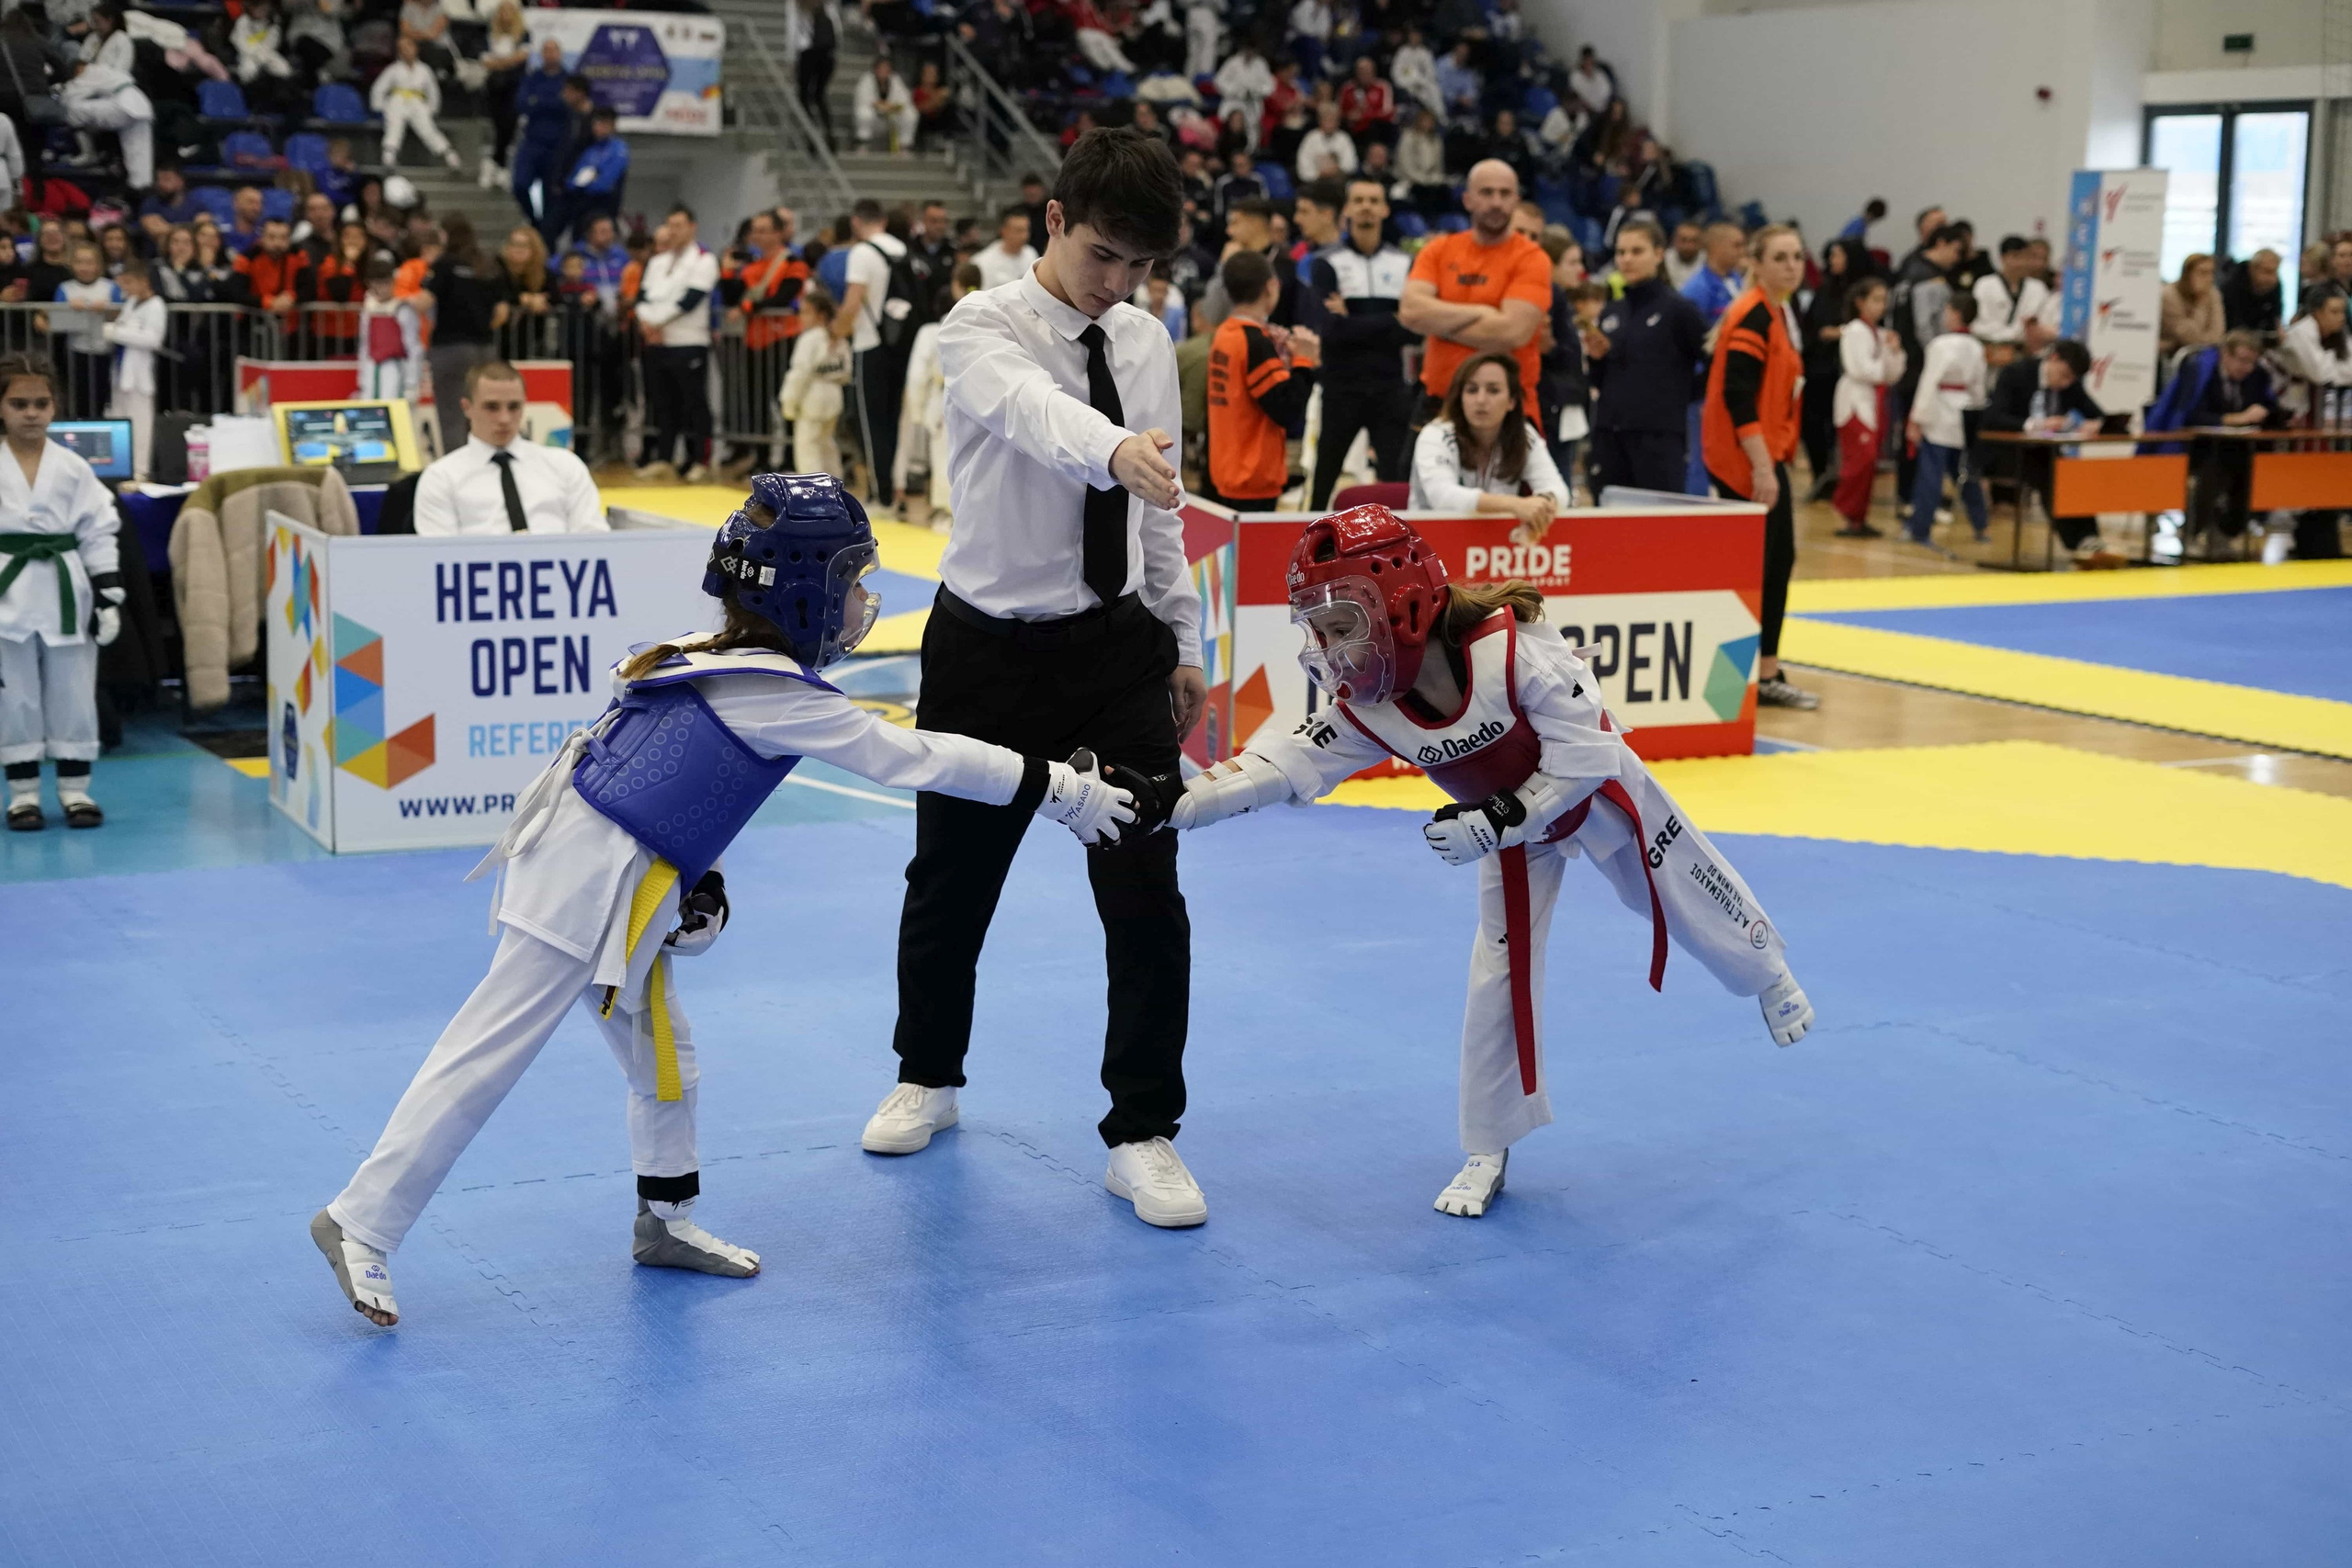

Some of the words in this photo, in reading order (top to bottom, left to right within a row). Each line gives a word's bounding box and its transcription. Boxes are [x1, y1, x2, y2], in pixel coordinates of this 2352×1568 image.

[1465, 544, 1572, 579] PRIDE
[436, 559, 617, 623] HEREYA
[470, 634, 591, 698] OPEN
[1559, 621, 1692, 703] PEN
[469, 720, 598, 758] REFER
[1441, 720, 1505, 759] Daedo
[399, 793, 520, 818] WWW.PR
[1647, 814, 1683, 870] GRE
[365, 1269, 388, 1280] Daedo
